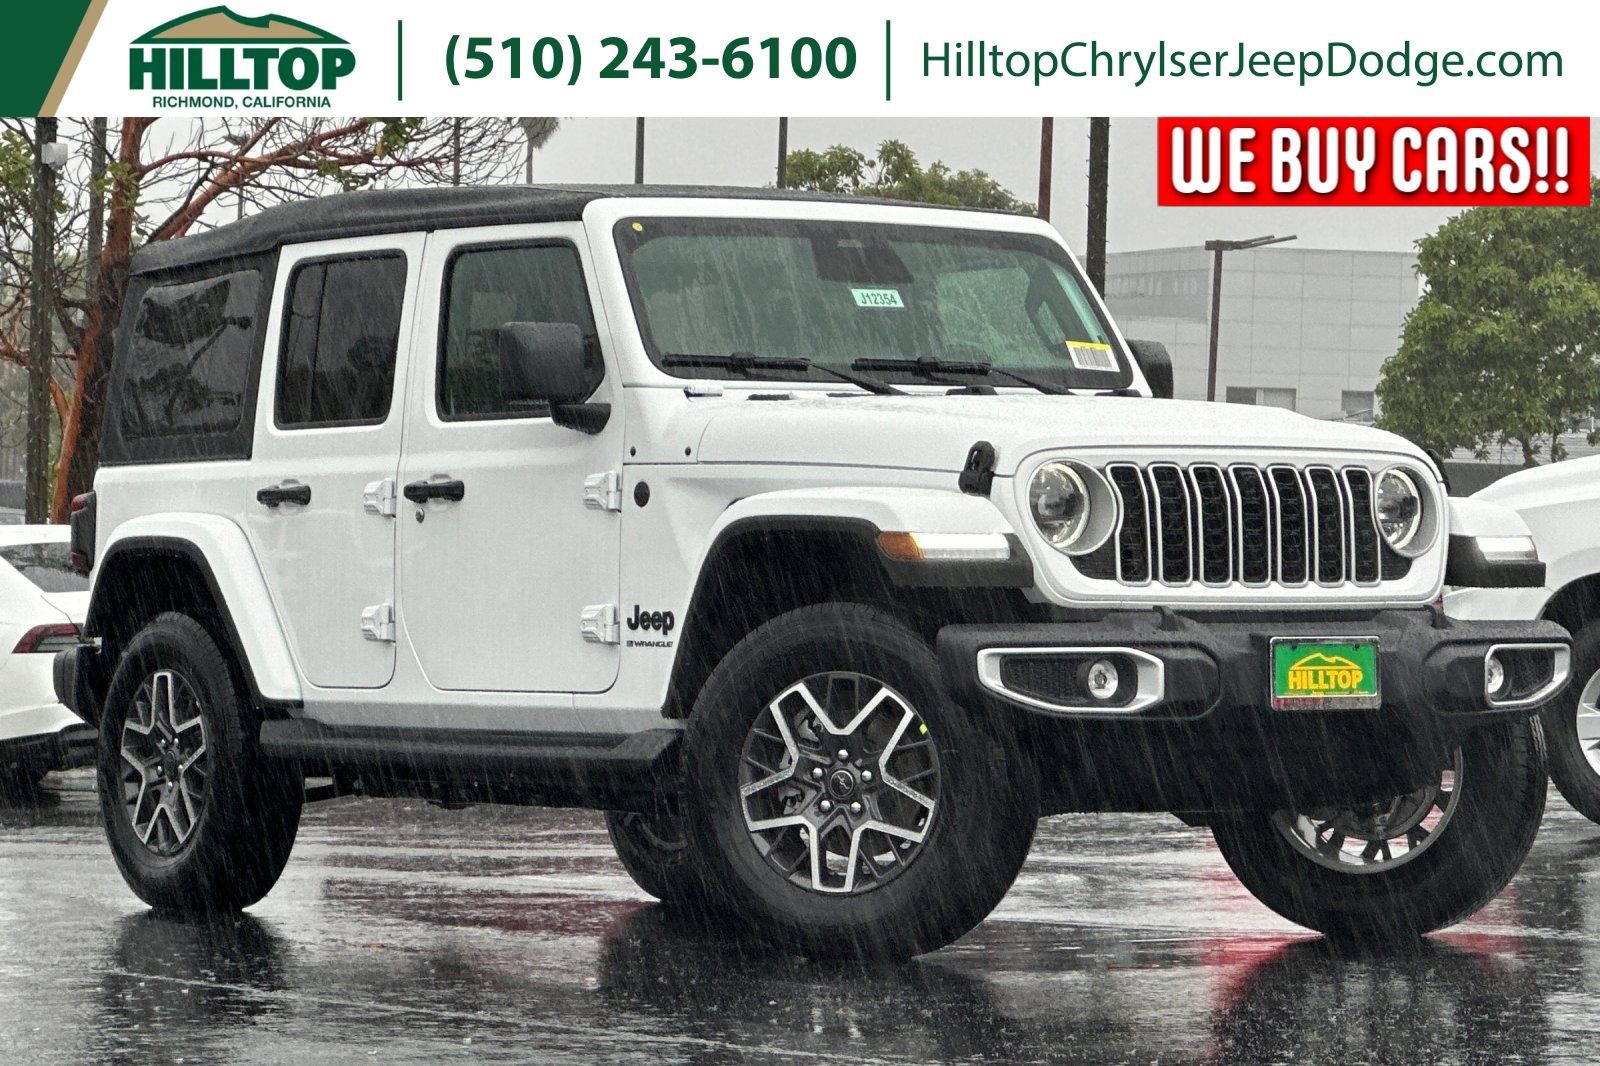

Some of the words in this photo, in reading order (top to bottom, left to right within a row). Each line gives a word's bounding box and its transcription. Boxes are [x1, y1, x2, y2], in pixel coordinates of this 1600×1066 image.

[860, 293, 897, 305] J12354
[627, 605, 674, 635] Jeep
[1288, 670, 1363, 689] HILLTOP
